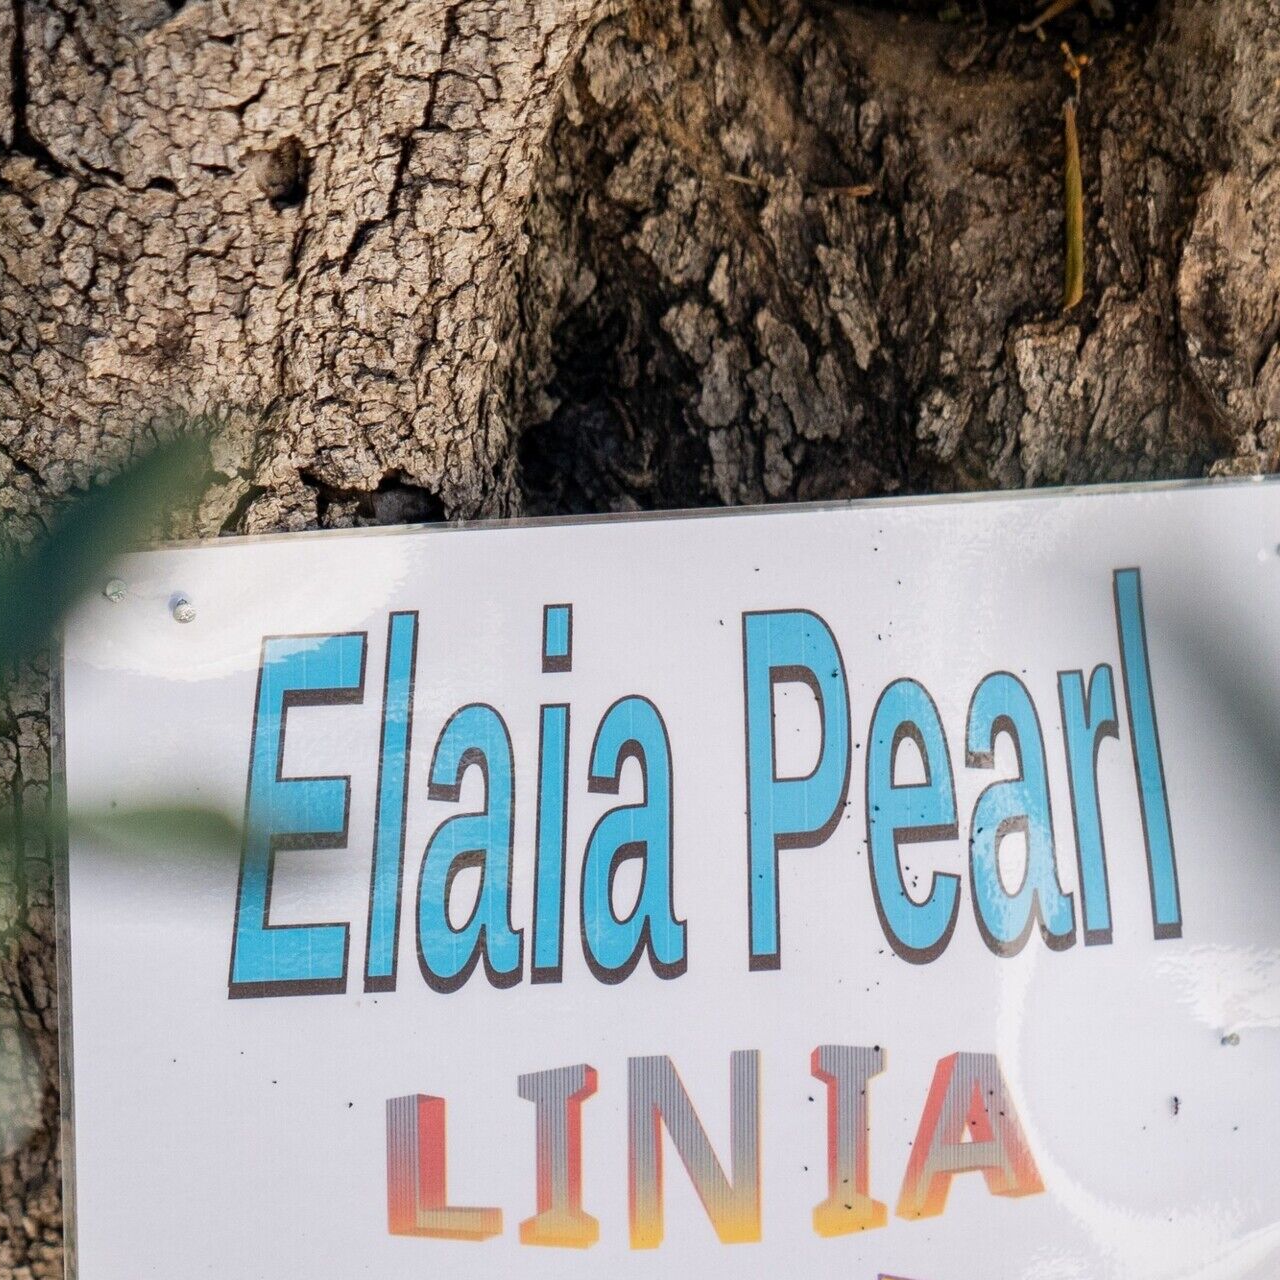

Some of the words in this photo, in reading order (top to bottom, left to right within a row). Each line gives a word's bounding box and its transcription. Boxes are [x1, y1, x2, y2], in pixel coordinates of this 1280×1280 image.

[228, 603, 688, 1000] Elaia
[742, 567, 1184, 972] Pearl
[385, 1045, 1045, 1251] LINIA
